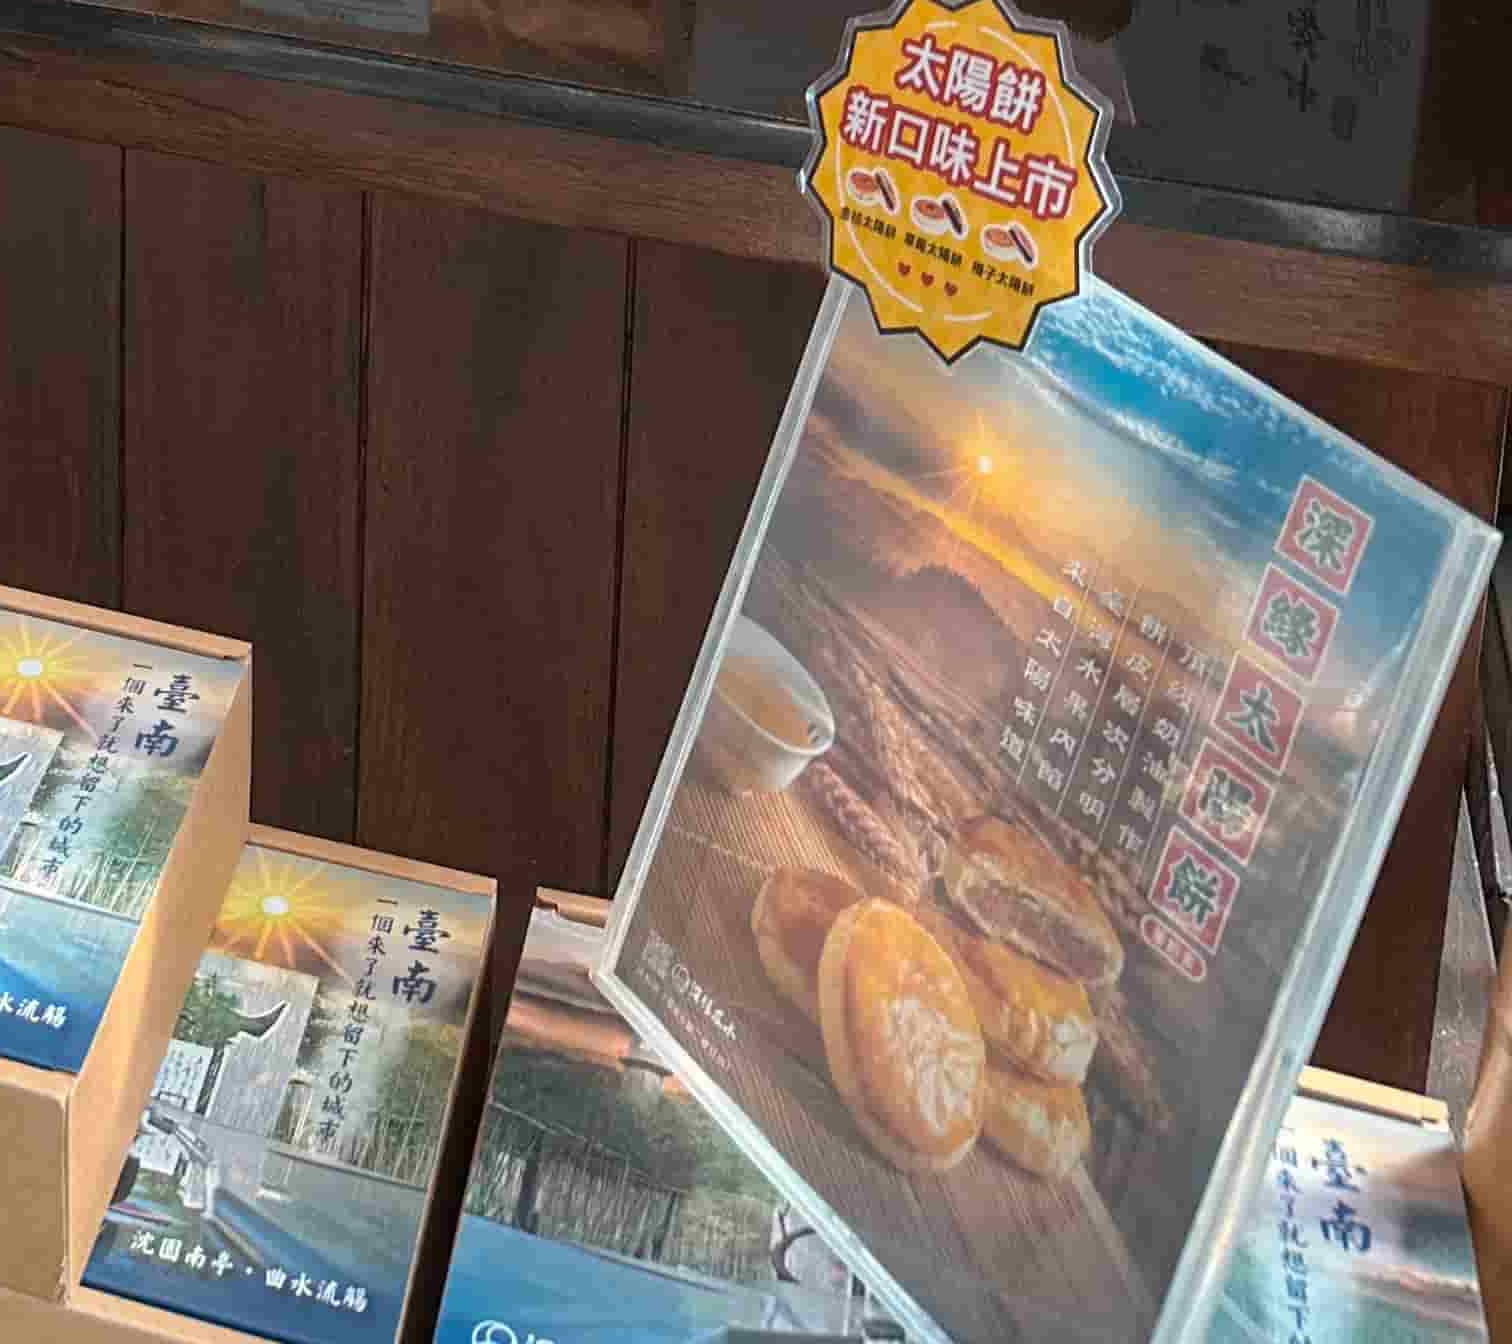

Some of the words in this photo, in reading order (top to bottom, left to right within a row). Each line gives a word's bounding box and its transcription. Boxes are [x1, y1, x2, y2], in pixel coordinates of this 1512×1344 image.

[897, 37, 1044, 131] 太陽餅
[842, 89, 1077, 219] 新口味上市
[135, 674, 201, 757] 臺南
[392, 909, 452, 1004] 臺南
